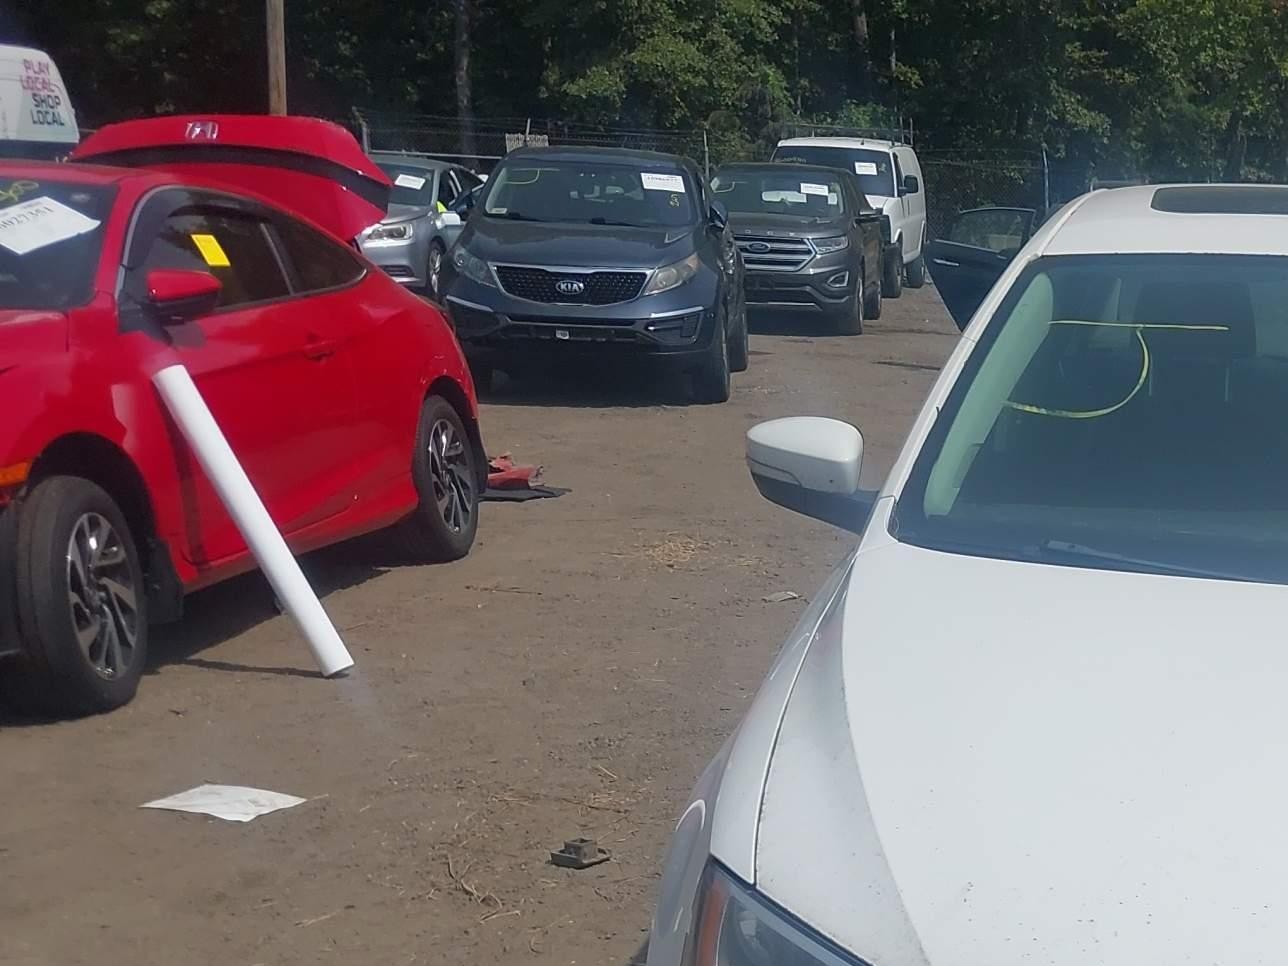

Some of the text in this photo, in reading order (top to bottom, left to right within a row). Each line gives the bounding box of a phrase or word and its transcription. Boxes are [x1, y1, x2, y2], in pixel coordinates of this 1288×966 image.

[23, 59, 51, 76] PLAY
[20, 75, 56, 93] LOCAL
[31, 92, 62, 110] SHOP
[30, 109, 65, 127] LOCAL
[560, 281, 580, 292] KIA
